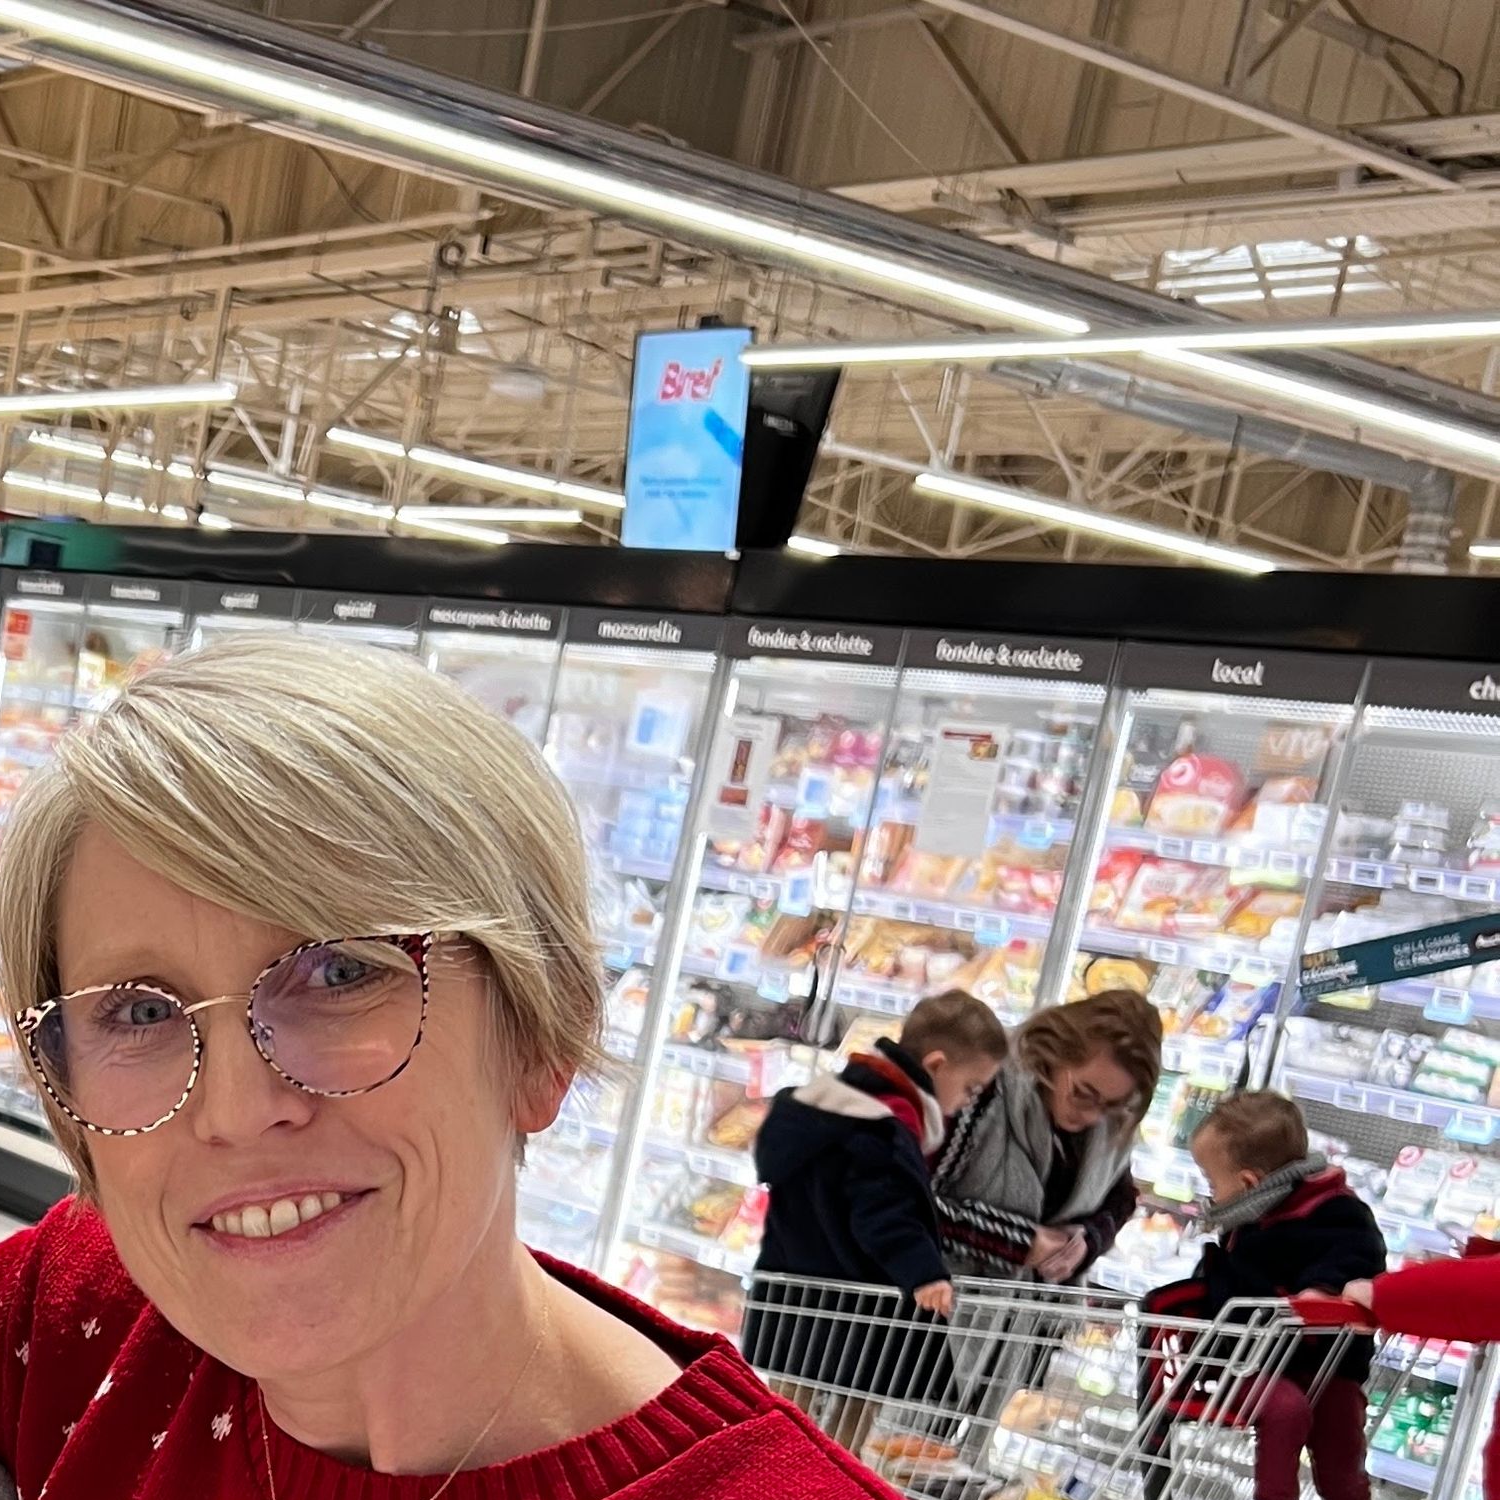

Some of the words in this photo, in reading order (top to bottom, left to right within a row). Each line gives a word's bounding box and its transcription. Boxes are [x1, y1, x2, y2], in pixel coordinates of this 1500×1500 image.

[597, 619, 682, 644] mozzarella
[747, 625, 799, 651] fondue
[811, 631, 873, 656] raclette
[935, 637, 995, 665] fondue
[1012, 645, 1083, 672] raclette
[1211, 657, 1265, 687] local
